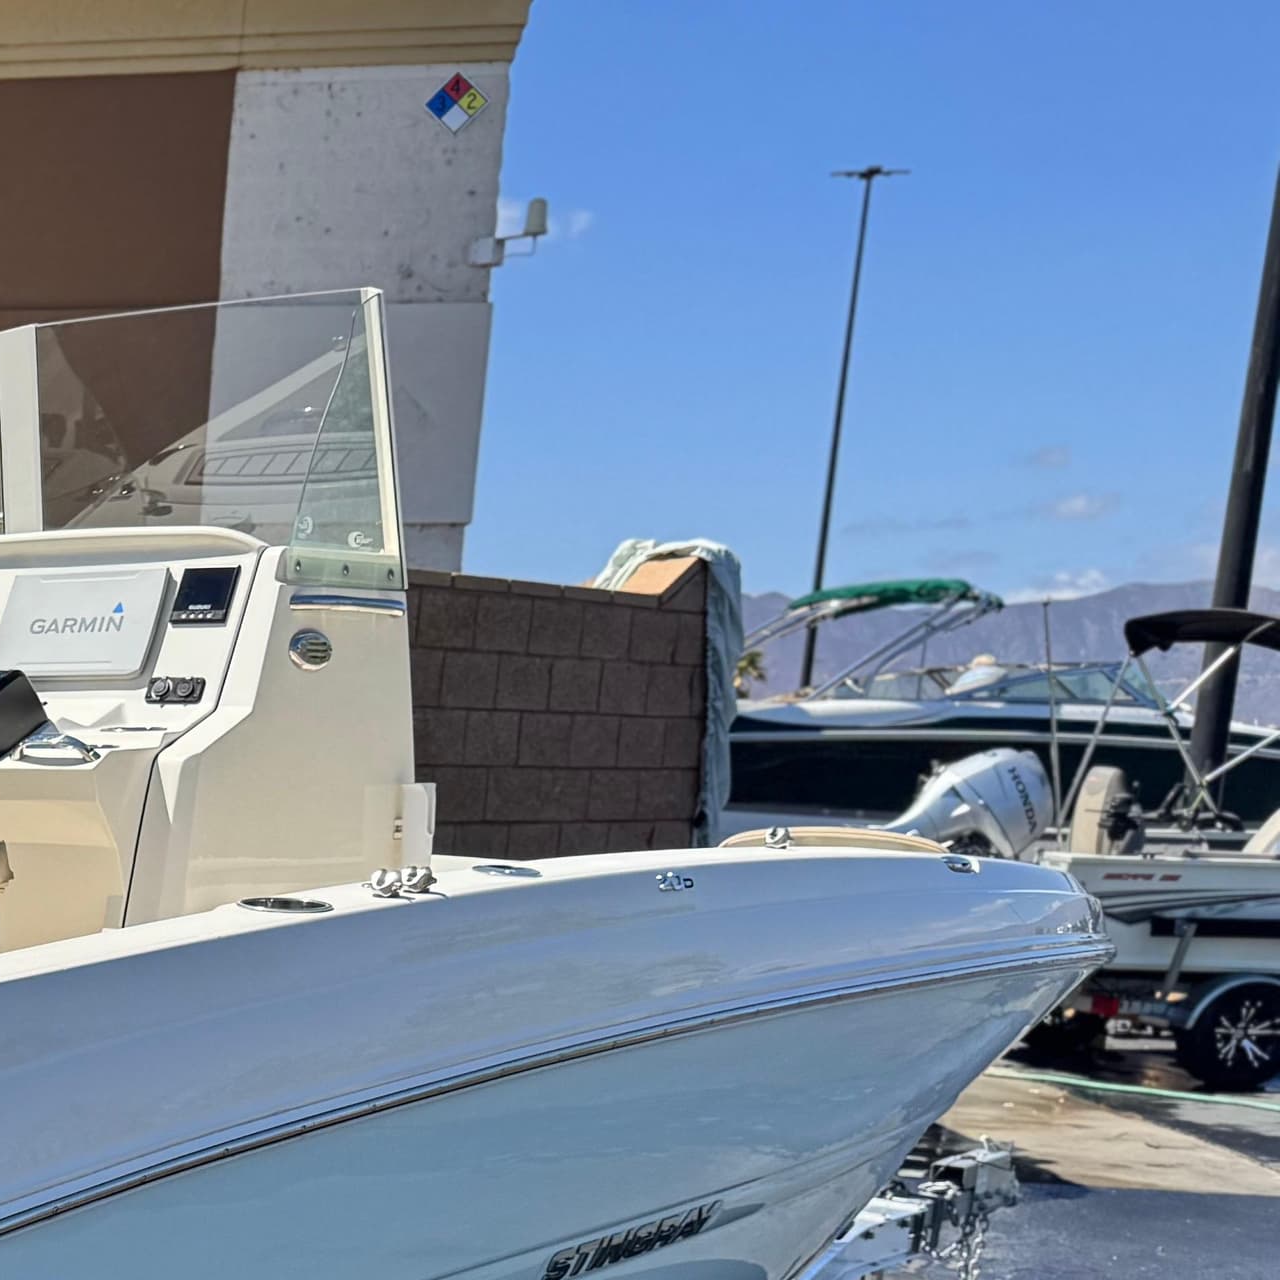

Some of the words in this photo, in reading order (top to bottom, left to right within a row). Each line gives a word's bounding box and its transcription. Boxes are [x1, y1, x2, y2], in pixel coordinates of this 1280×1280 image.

[467, 92, 478, 110] 2
[30, 616, 124, 635] GARMIN
[1008, 766, 1037, 835] HONDA
